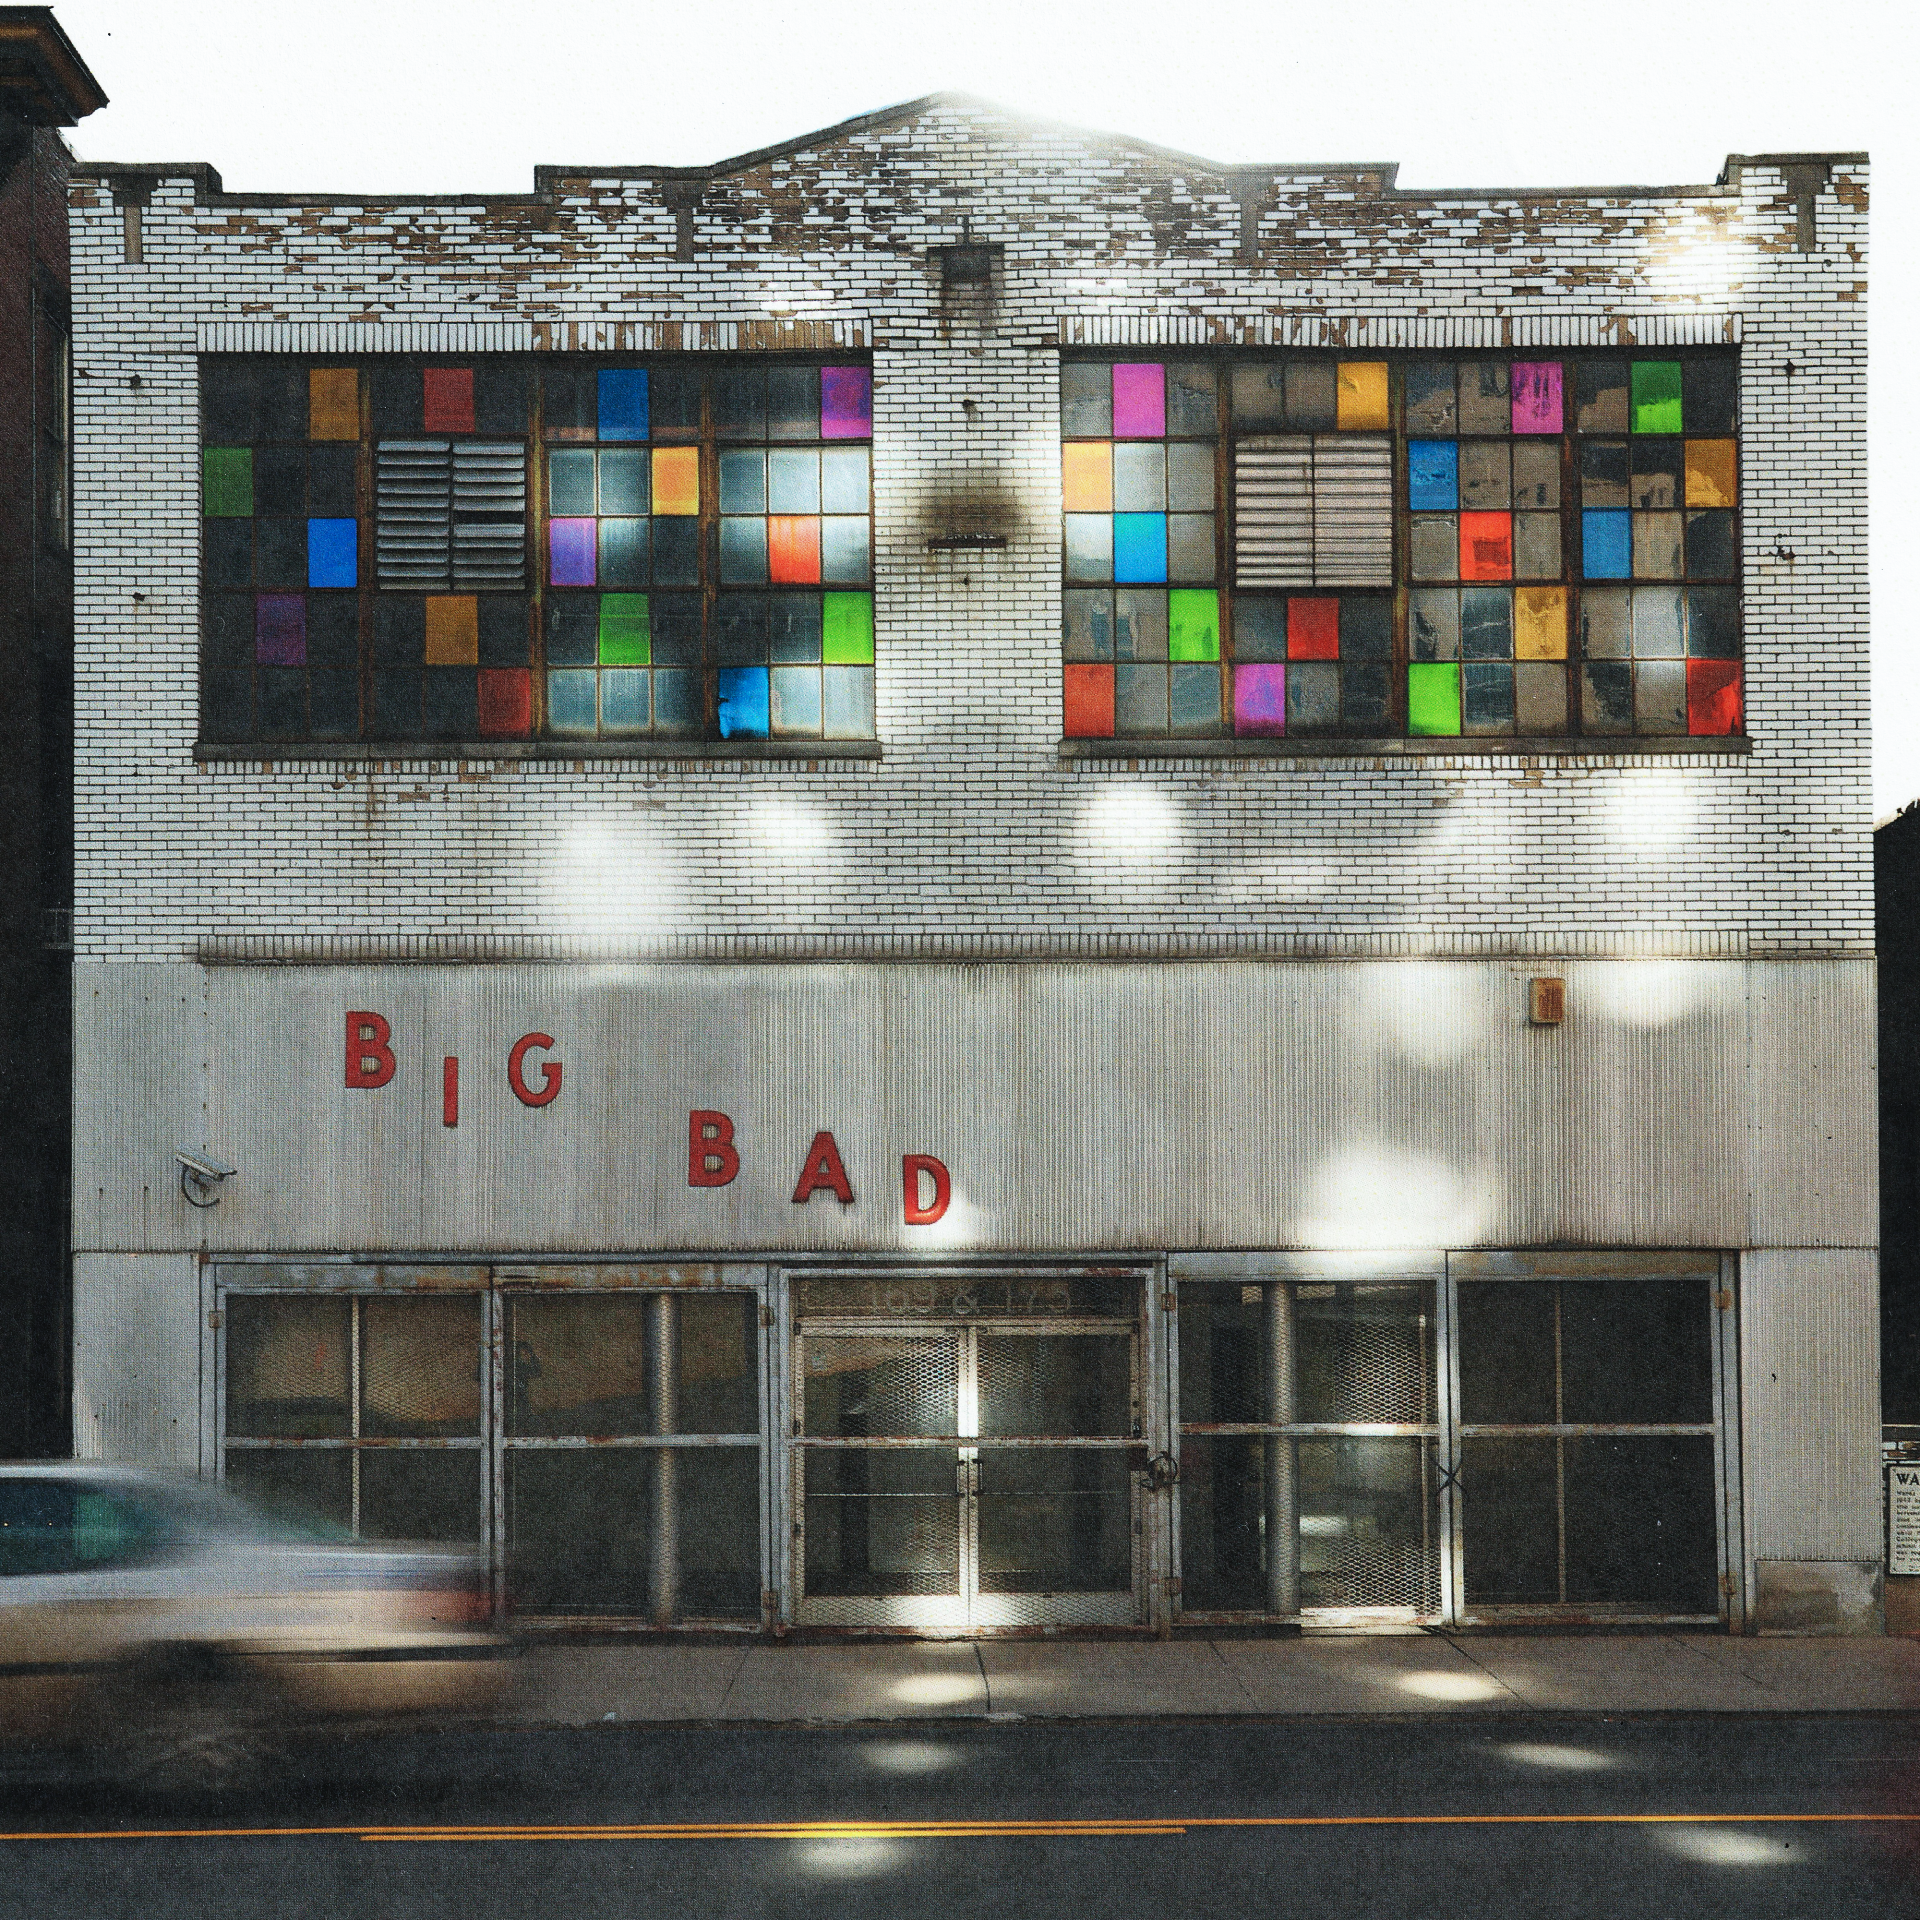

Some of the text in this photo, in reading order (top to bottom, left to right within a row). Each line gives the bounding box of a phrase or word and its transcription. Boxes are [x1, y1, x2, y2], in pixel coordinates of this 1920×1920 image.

[345, 1010, 952, 1226] BIG BAD
[951, 1283, 980, 1316] &
